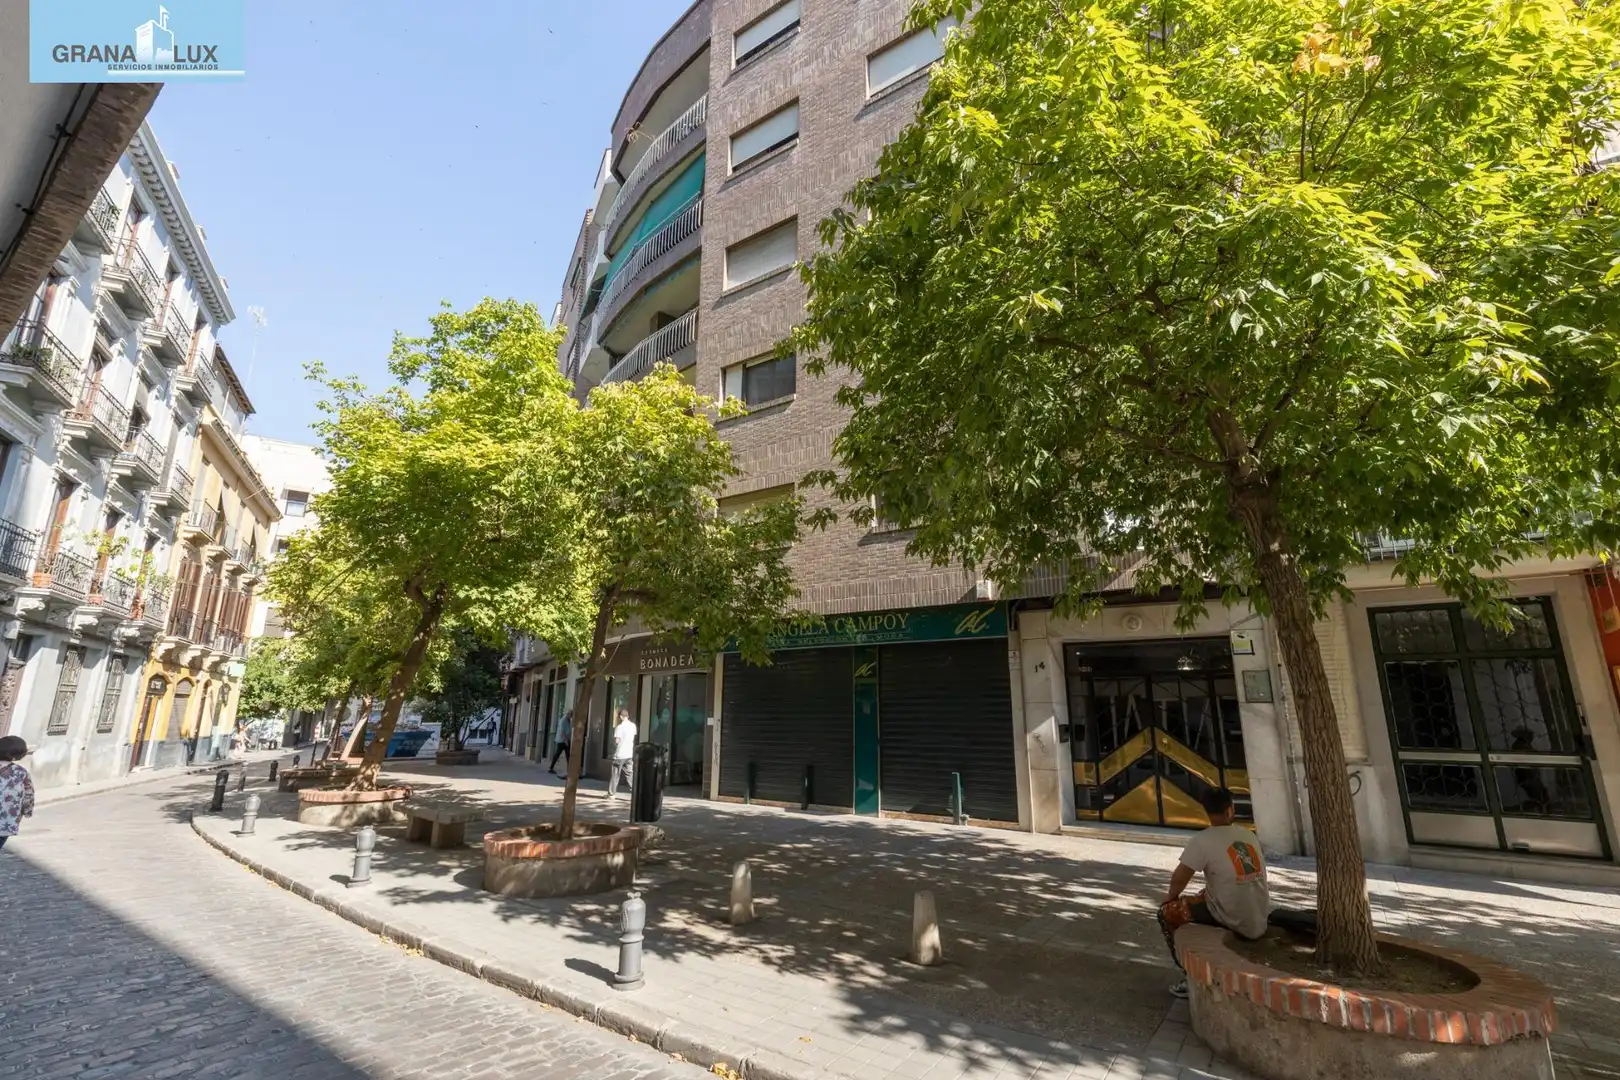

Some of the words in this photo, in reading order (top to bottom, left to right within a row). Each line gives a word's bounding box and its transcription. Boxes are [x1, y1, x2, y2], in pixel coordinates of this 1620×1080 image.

[834, 612, 910, 634] CAMPOY
[640, 654, 695, 670] BONADEA
[1035, 661, 1046, 673] 14
